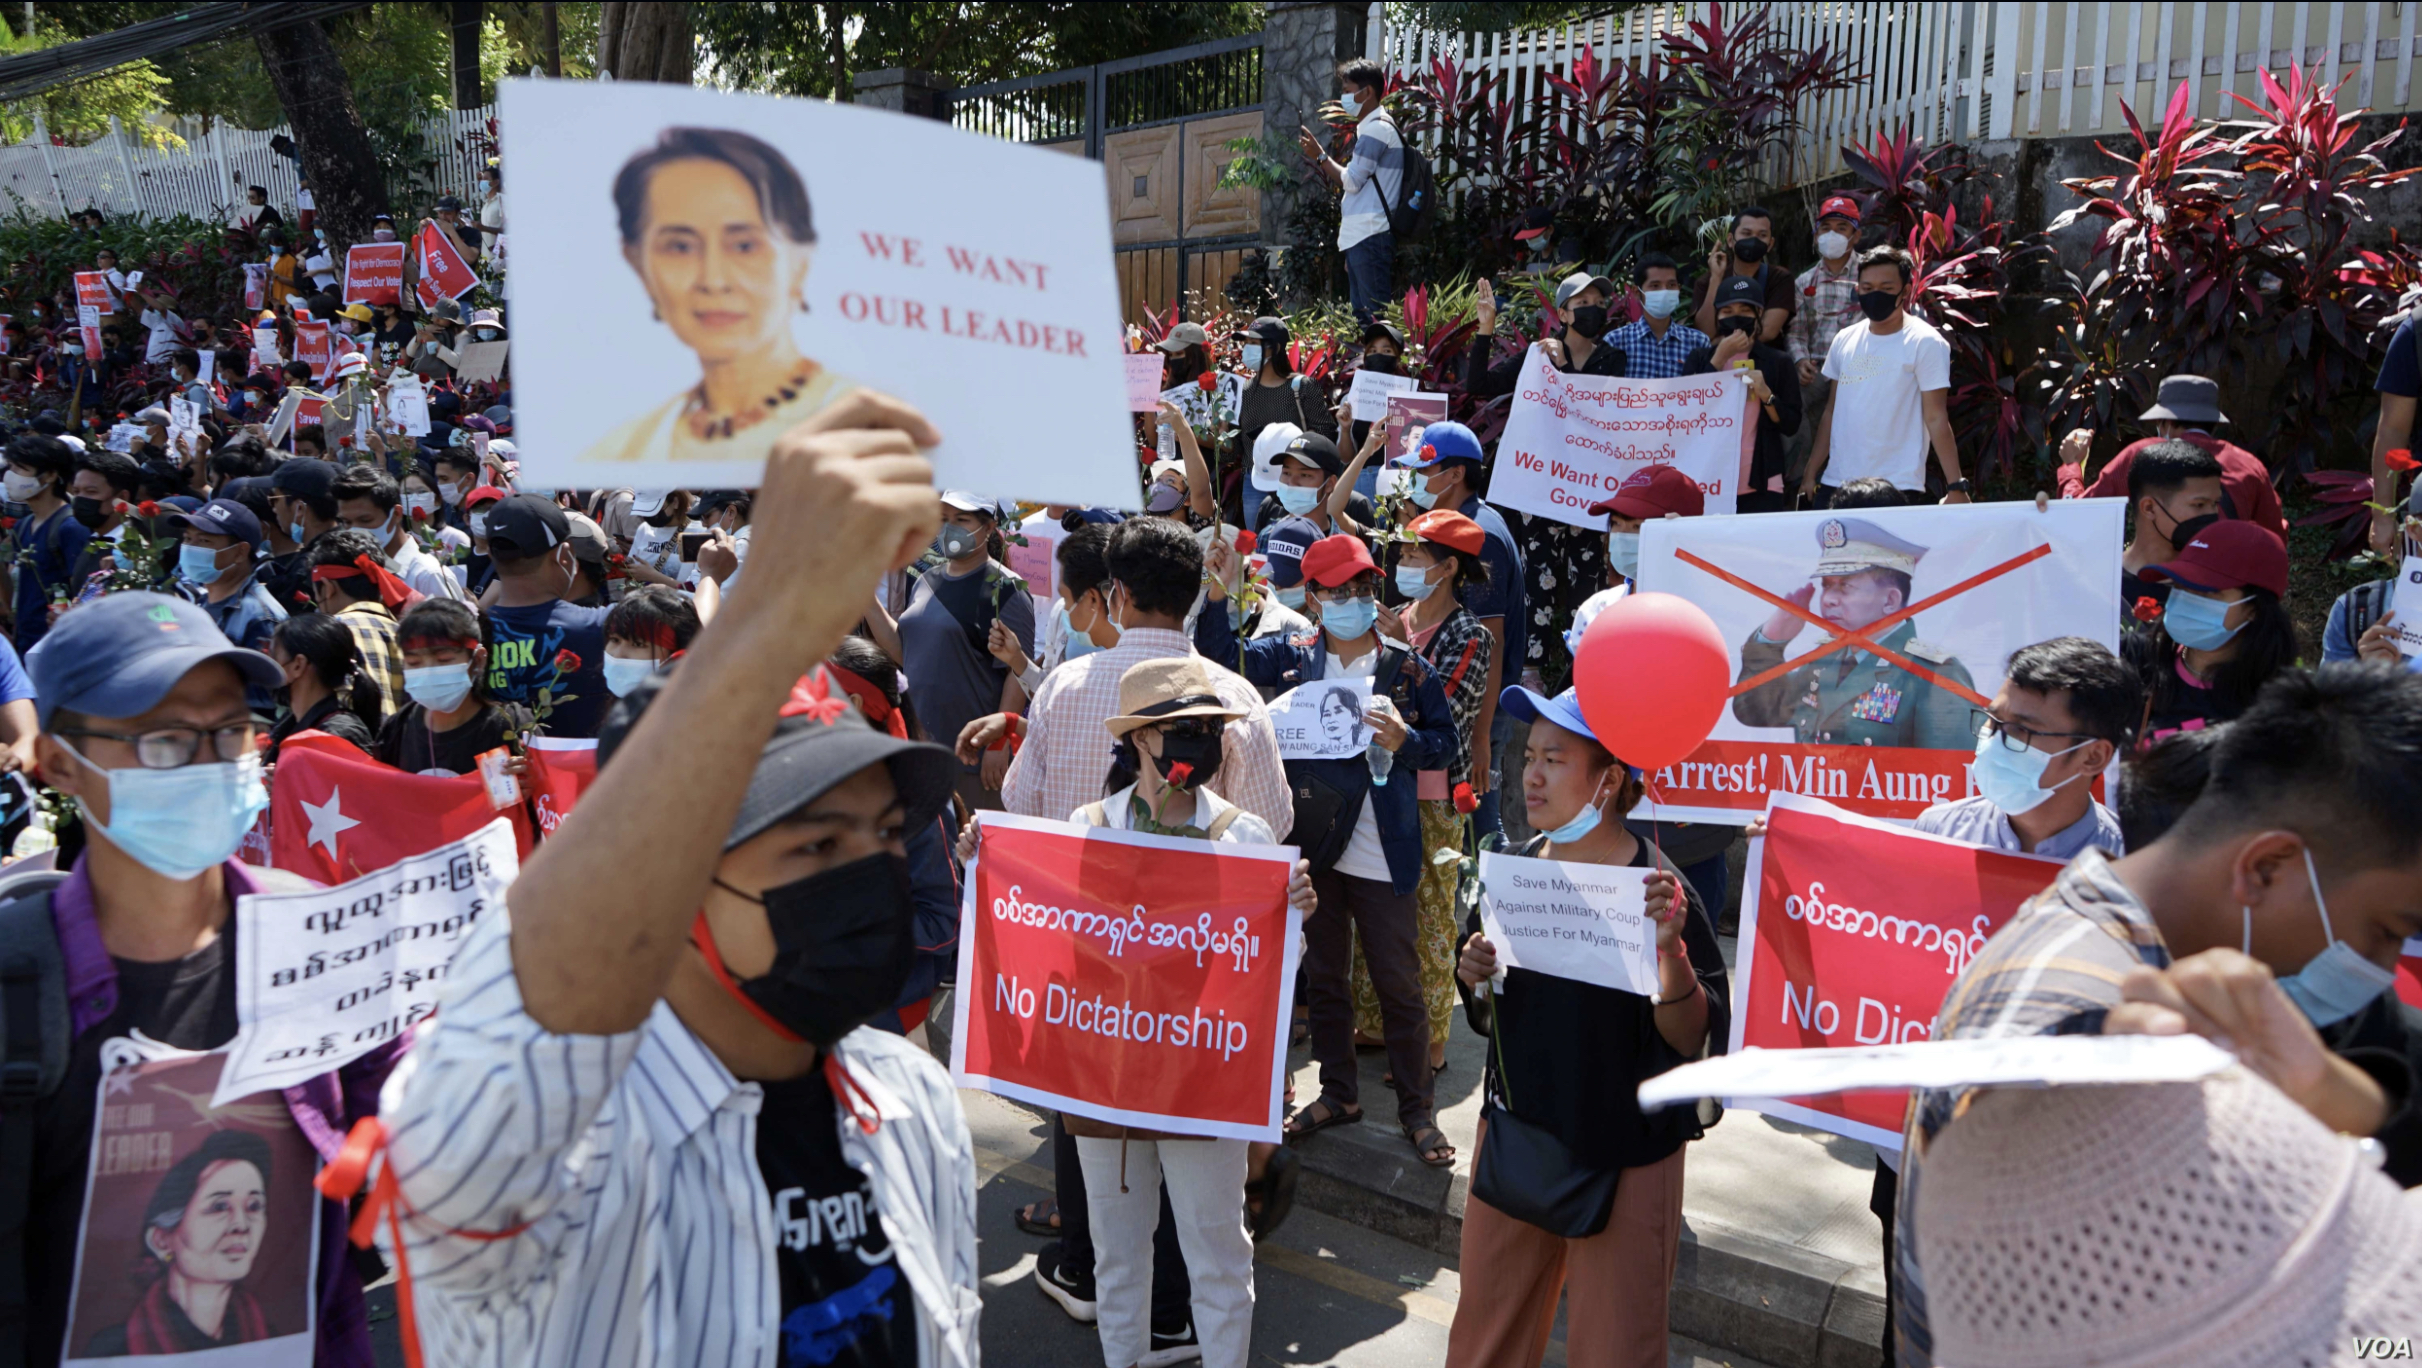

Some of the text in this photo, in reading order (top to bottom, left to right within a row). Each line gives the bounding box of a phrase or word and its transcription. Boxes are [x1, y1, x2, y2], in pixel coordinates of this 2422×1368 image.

[376, 258, 401, 269] Democracy
[428, 249, 448, 273] Free
[859, 231, 1049, 291] WE WANT
[350, 277, 372, 289] Respect
[373, 276, 385, 287] Our
[839, 291, 1088, 357] OUR LEADER
[298, 411, 321, 425] Save
[1514, 450, 1544, 472] We
[1550, 460, 1598, 489] Want
[1033, 572, 1047, 586] Coup
[1274, 727, 1306, 740] REE
[1289, 742, 1317, 751] AUNG
[1654, 753, 1768, 793] Arrest!
[1780, 755, 1849, 797] Min
[1857, 758, 1951, 804] Aung
[1512, 875, 1618, 894] Save Myanmar
[1496, 899, 1641, 928] Against Military Coup
[1502, 924, 1641, 954] Justice For Myanmar
[995, 973, 1248, 1062] No Dictatorship
[1782, 980, 1840, 1036] No
